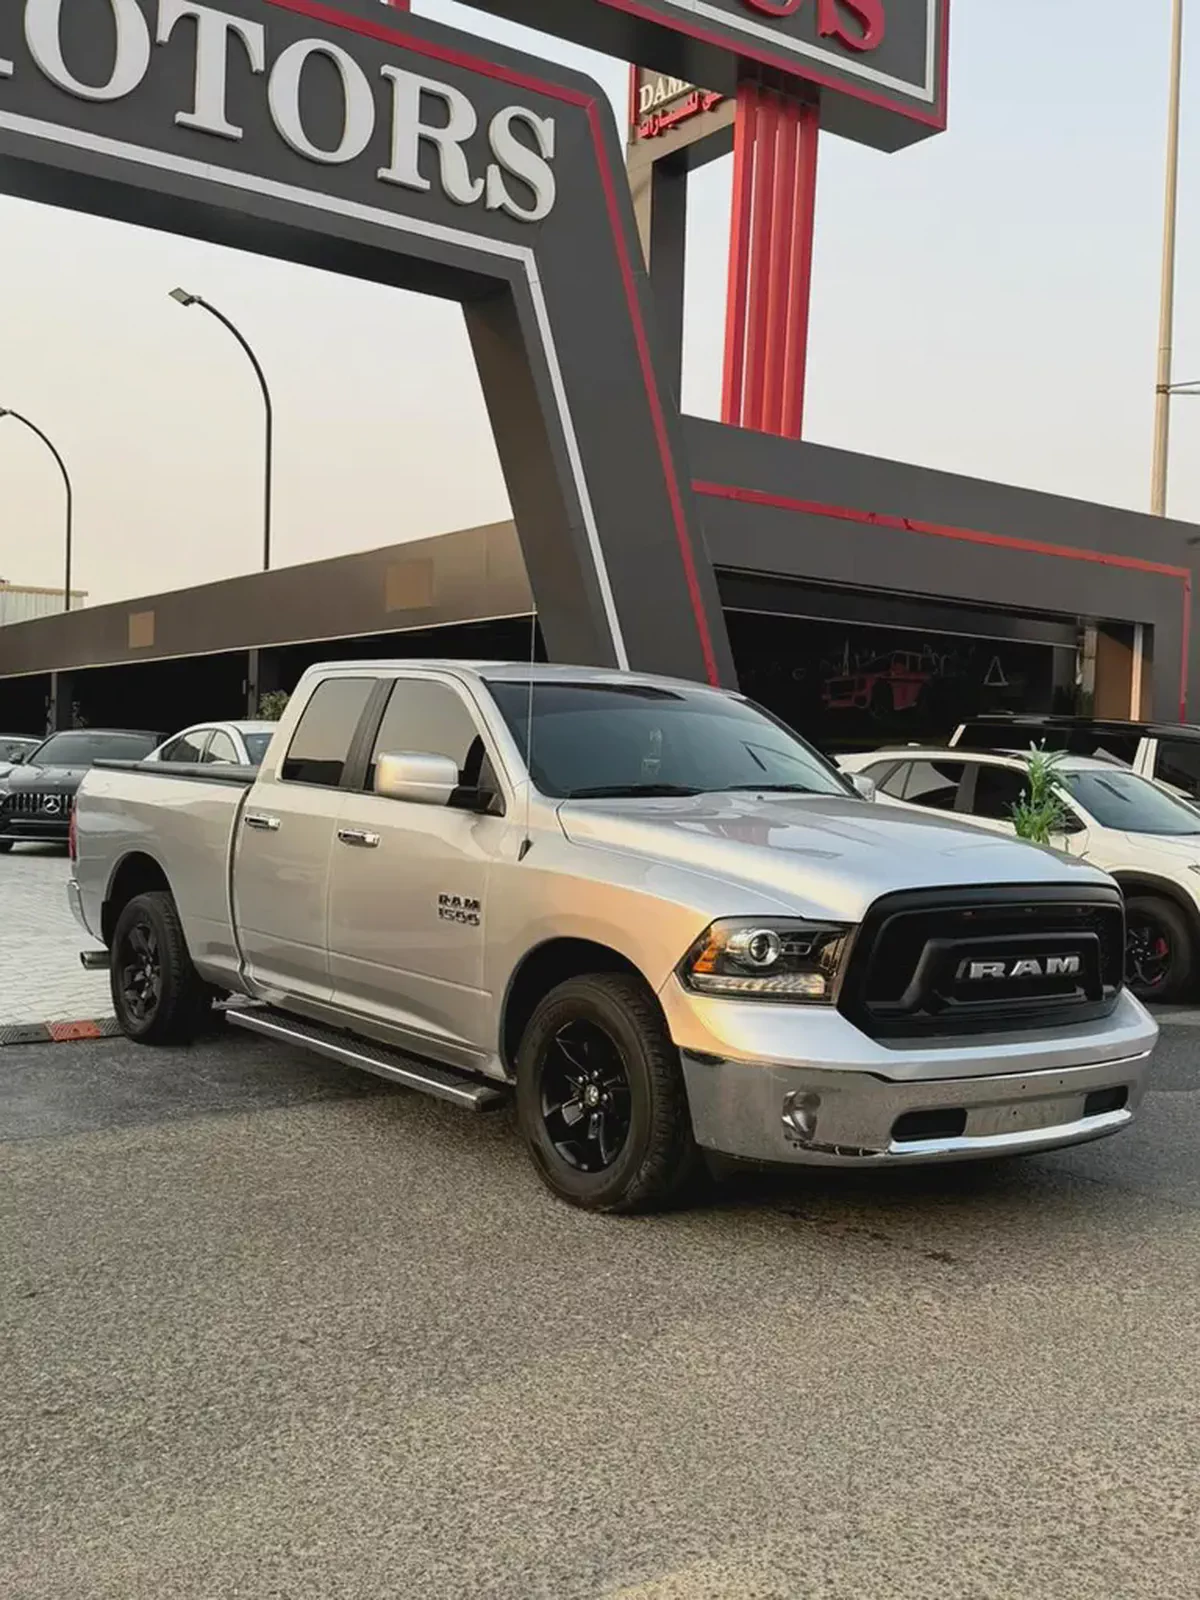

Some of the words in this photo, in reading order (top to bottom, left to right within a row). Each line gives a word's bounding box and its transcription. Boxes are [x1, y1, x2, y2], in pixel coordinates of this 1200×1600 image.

[639, 76, 696, 113] DAM
[0, 0, 557, 222] OTORS
[438, 893, 481, 912] RAM
[969, 956, 1080, 979] RAM
